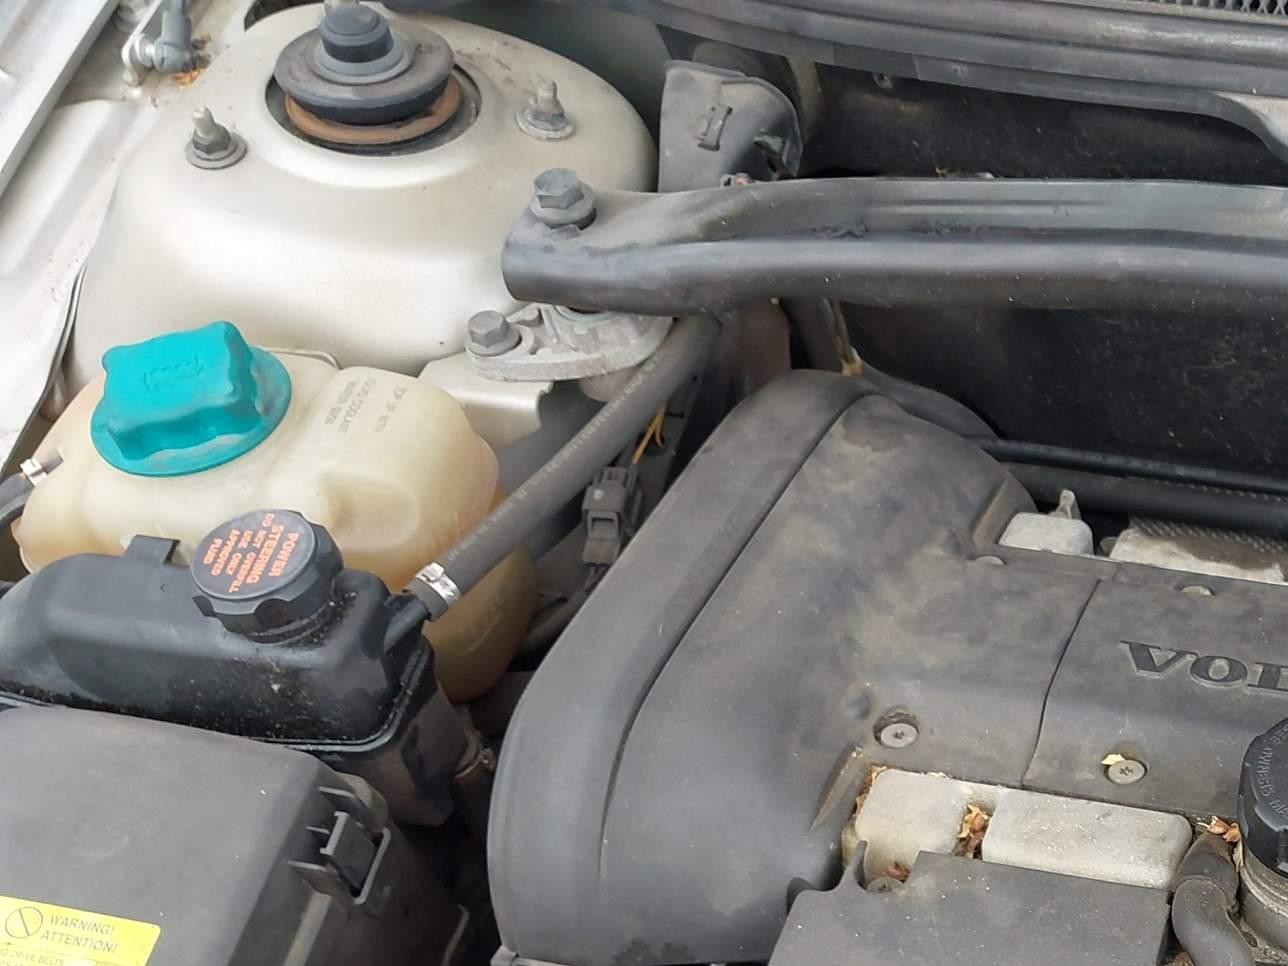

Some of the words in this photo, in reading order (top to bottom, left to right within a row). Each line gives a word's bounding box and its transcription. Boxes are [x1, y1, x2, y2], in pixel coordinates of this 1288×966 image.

[262, 512, 275, 528] DO
[203, 538, 222, 564] FLUID
[246, 524, 284, 584] STEERING
[268, 533, 299, 577] POWER
[228, 552, 257, 593] OVERFILL
[50, 913, 115, 935] WARNING!
[40, 930, 118, 954] ATTENTION!
